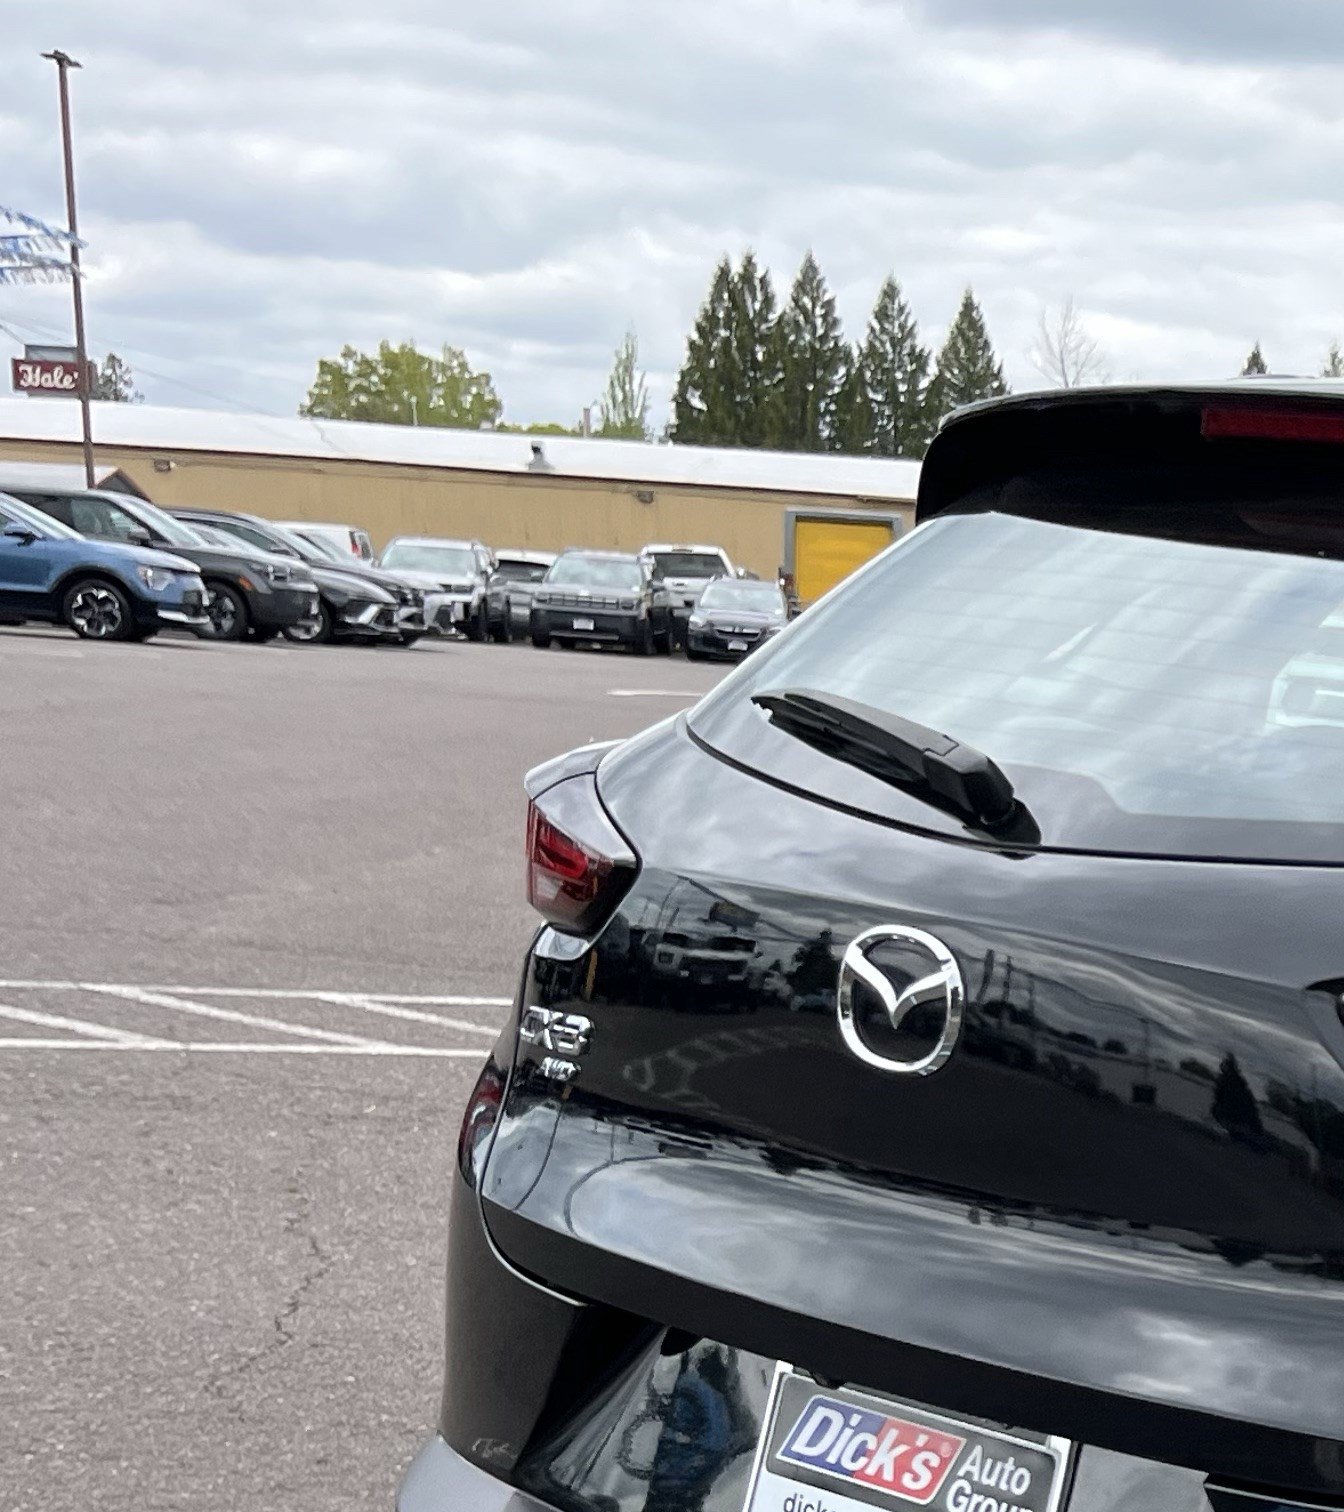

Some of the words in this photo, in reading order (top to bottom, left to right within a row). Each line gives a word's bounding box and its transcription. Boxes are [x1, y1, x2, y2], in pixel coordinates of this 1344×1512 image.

[18, 363, 82, 390] Hale'
[790, 1405, 941, 1492] Dick's
[956, 1445, 1032, 1497] Auto
